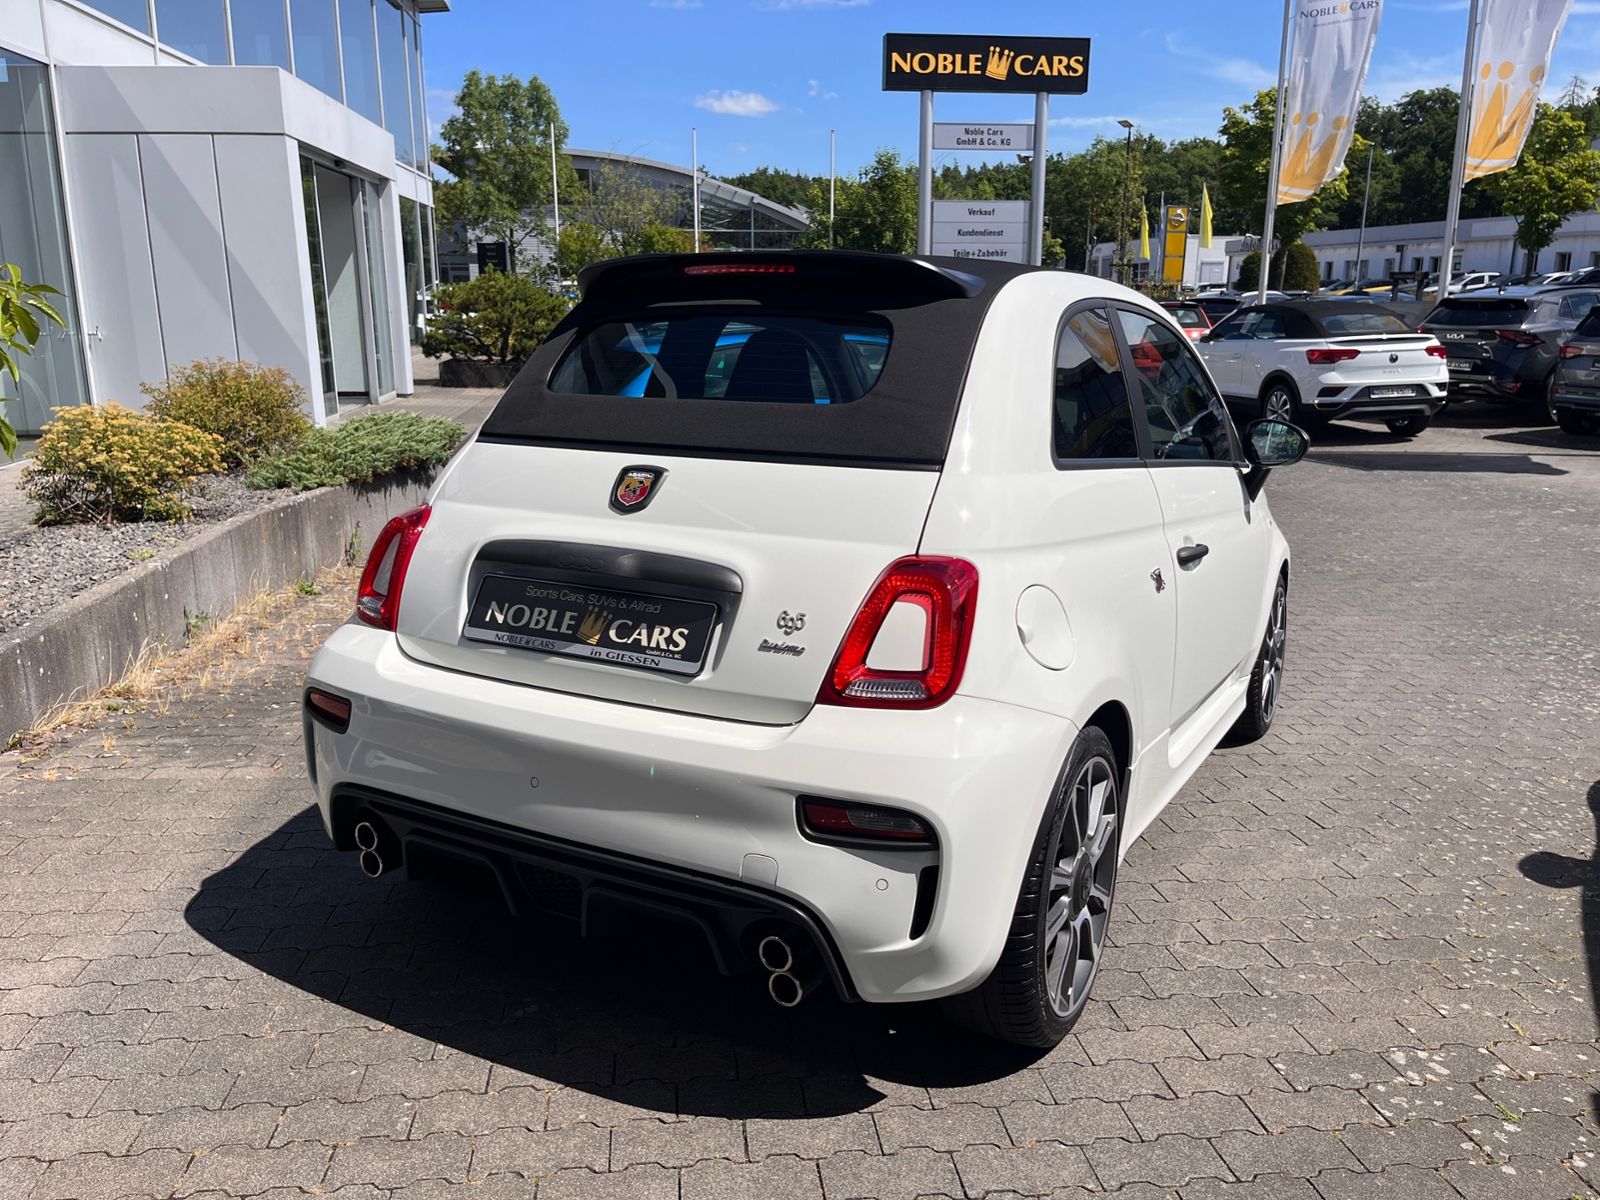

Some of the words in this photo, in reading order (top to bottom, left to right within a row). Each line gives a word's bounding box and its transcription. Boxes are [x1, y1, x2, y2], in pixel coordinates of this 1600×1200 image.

[1299, 5, 1338, 19] NOBLE
[1349, 0, 1379, 11] CARS
[890, 52, 982, 75] NOBLE
[1014, 54, 1084, 77] CARS
[964, 127, 985, 136] Noble
[987, 128, 1004, 136] Cars
[956, 137, 977, 146] GmbH
[978, 138, 985, 146] &
[987, 138, 999, 146] Co.
[1000, 138, 1011, 147] KG
[967, 207, 996, 217] Verkauf
[957, 228, 1004, 237] Kundendienst
[526, 585, 558, 599] Sports
[587, 594, 617, 608] SUVs
[618, 598, 628, 609] &
[629, 600, 662, 614] Allrad
[485, 600, 579, 635] NOBLE
[608, 619, 690, 652] CARS
[494, 633, 525, 645] NOBLE
[531, 638, 557, 650] CARS
[590, 648, 602, 657] in
[605, 651, 661, 667] GIESSEN
